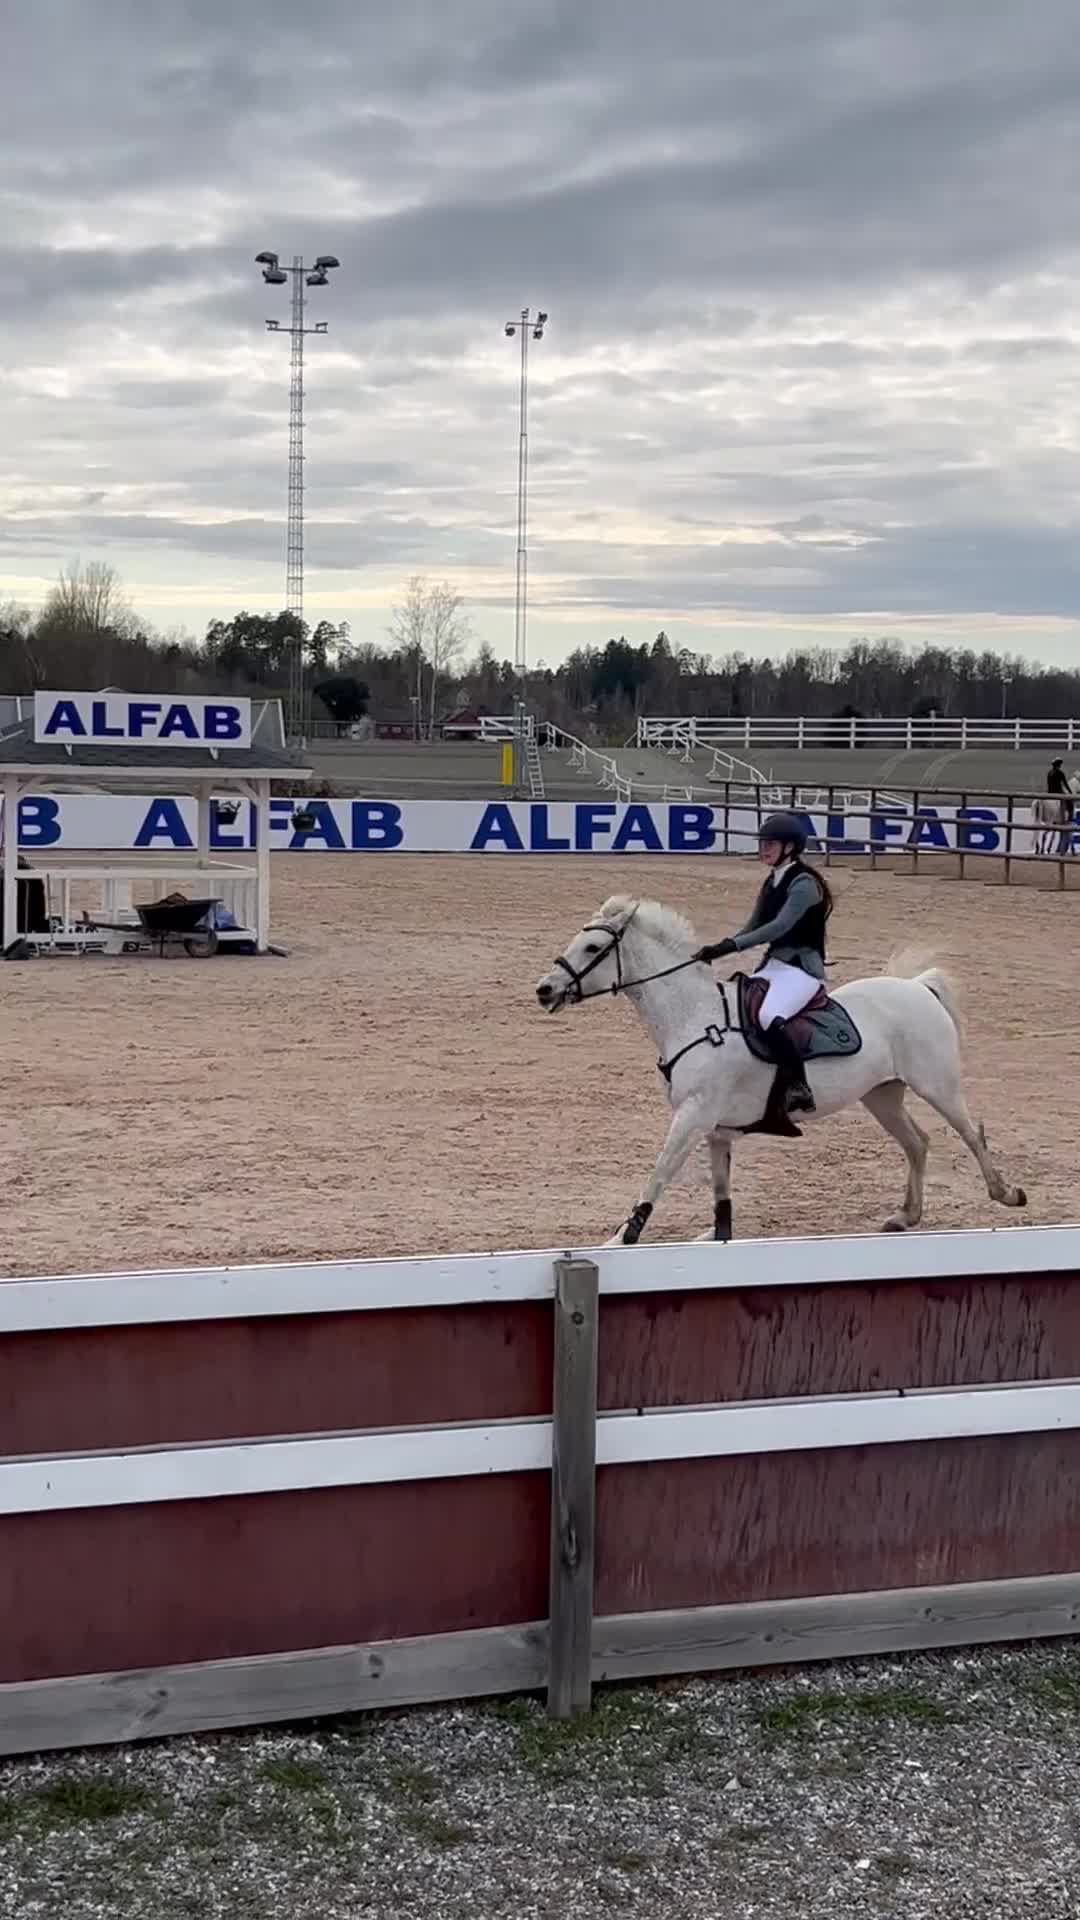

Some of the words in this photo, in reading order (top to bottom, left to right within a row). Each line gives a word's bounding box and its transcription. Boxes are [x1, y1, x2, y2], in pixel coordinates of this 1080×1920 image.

[44, 700, 243, 740] ALFAB
[133, 798, 404, 849] ALFAB
[469, 803, 715, 850] ALFAB
